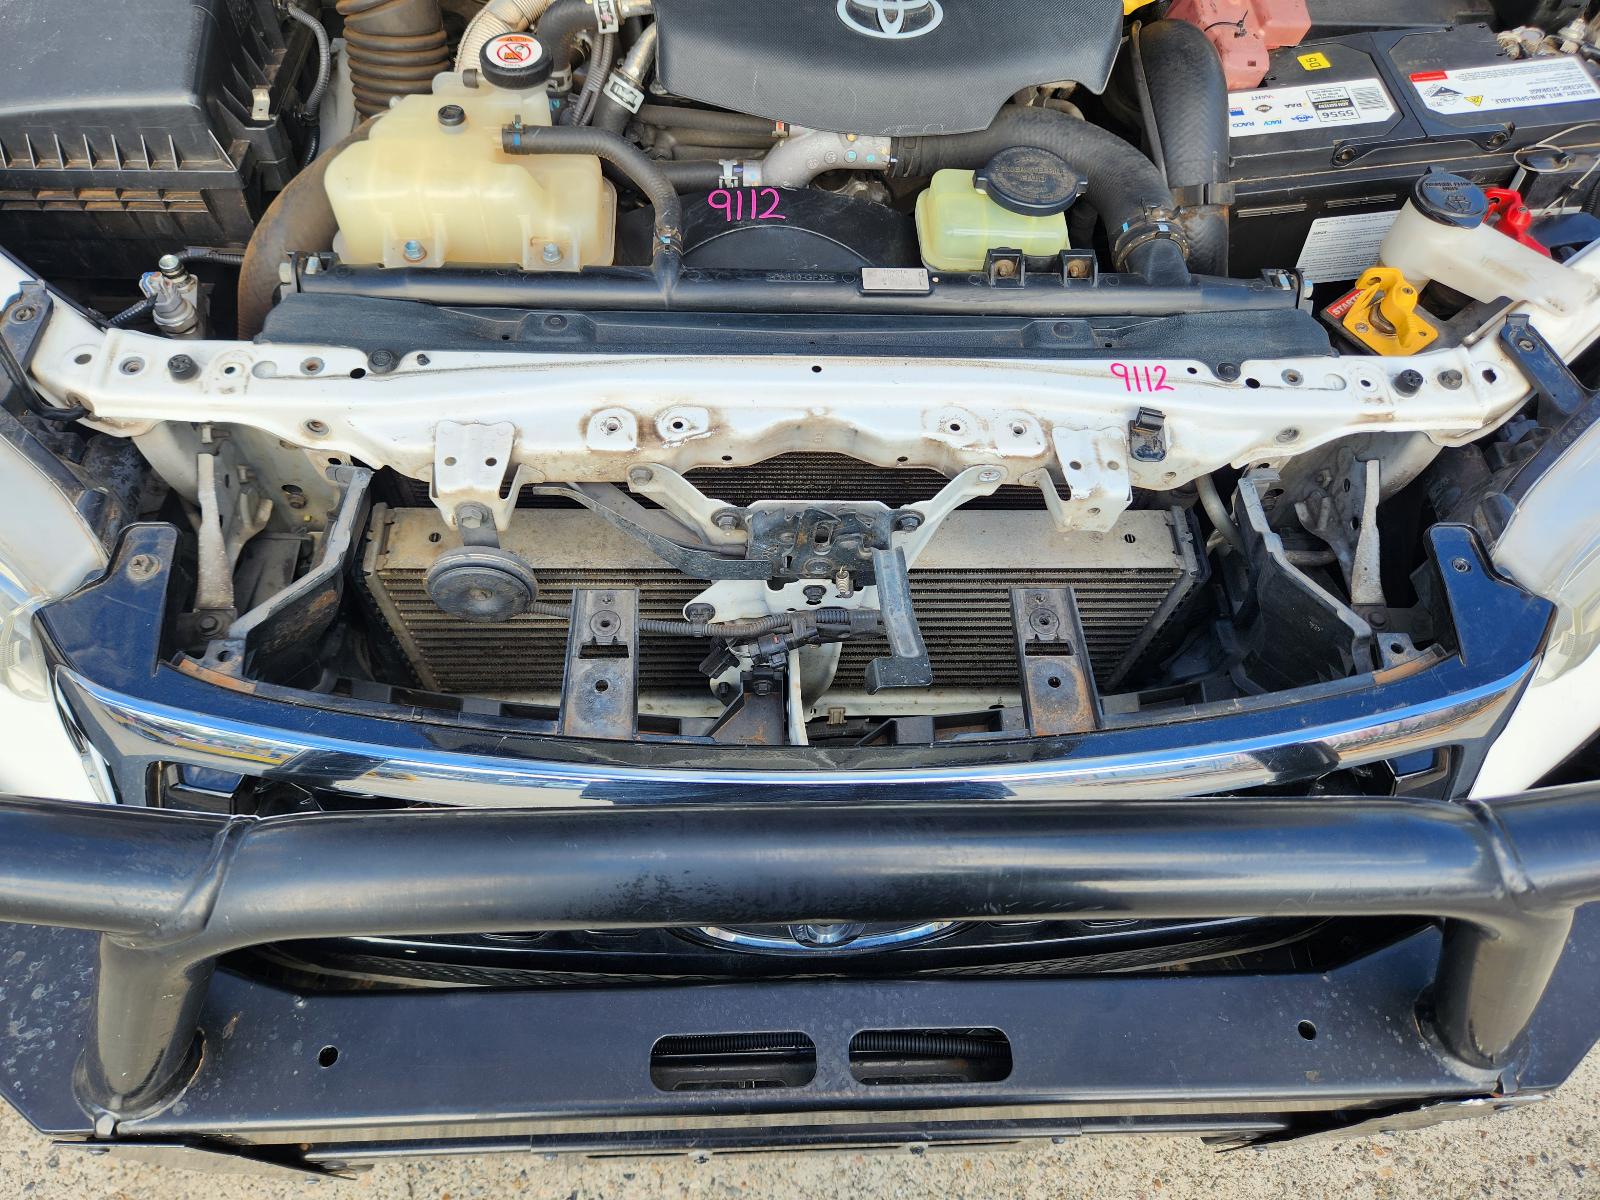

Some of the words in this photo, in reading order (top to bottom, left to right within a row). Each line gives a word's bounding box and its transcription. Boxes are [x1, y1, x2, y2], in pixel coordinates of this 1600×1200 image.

[1322, 109, 1355, 119] 5556
[707, 187, 786, 222] 9112
[1110, 362, 1175, 392] 9112
